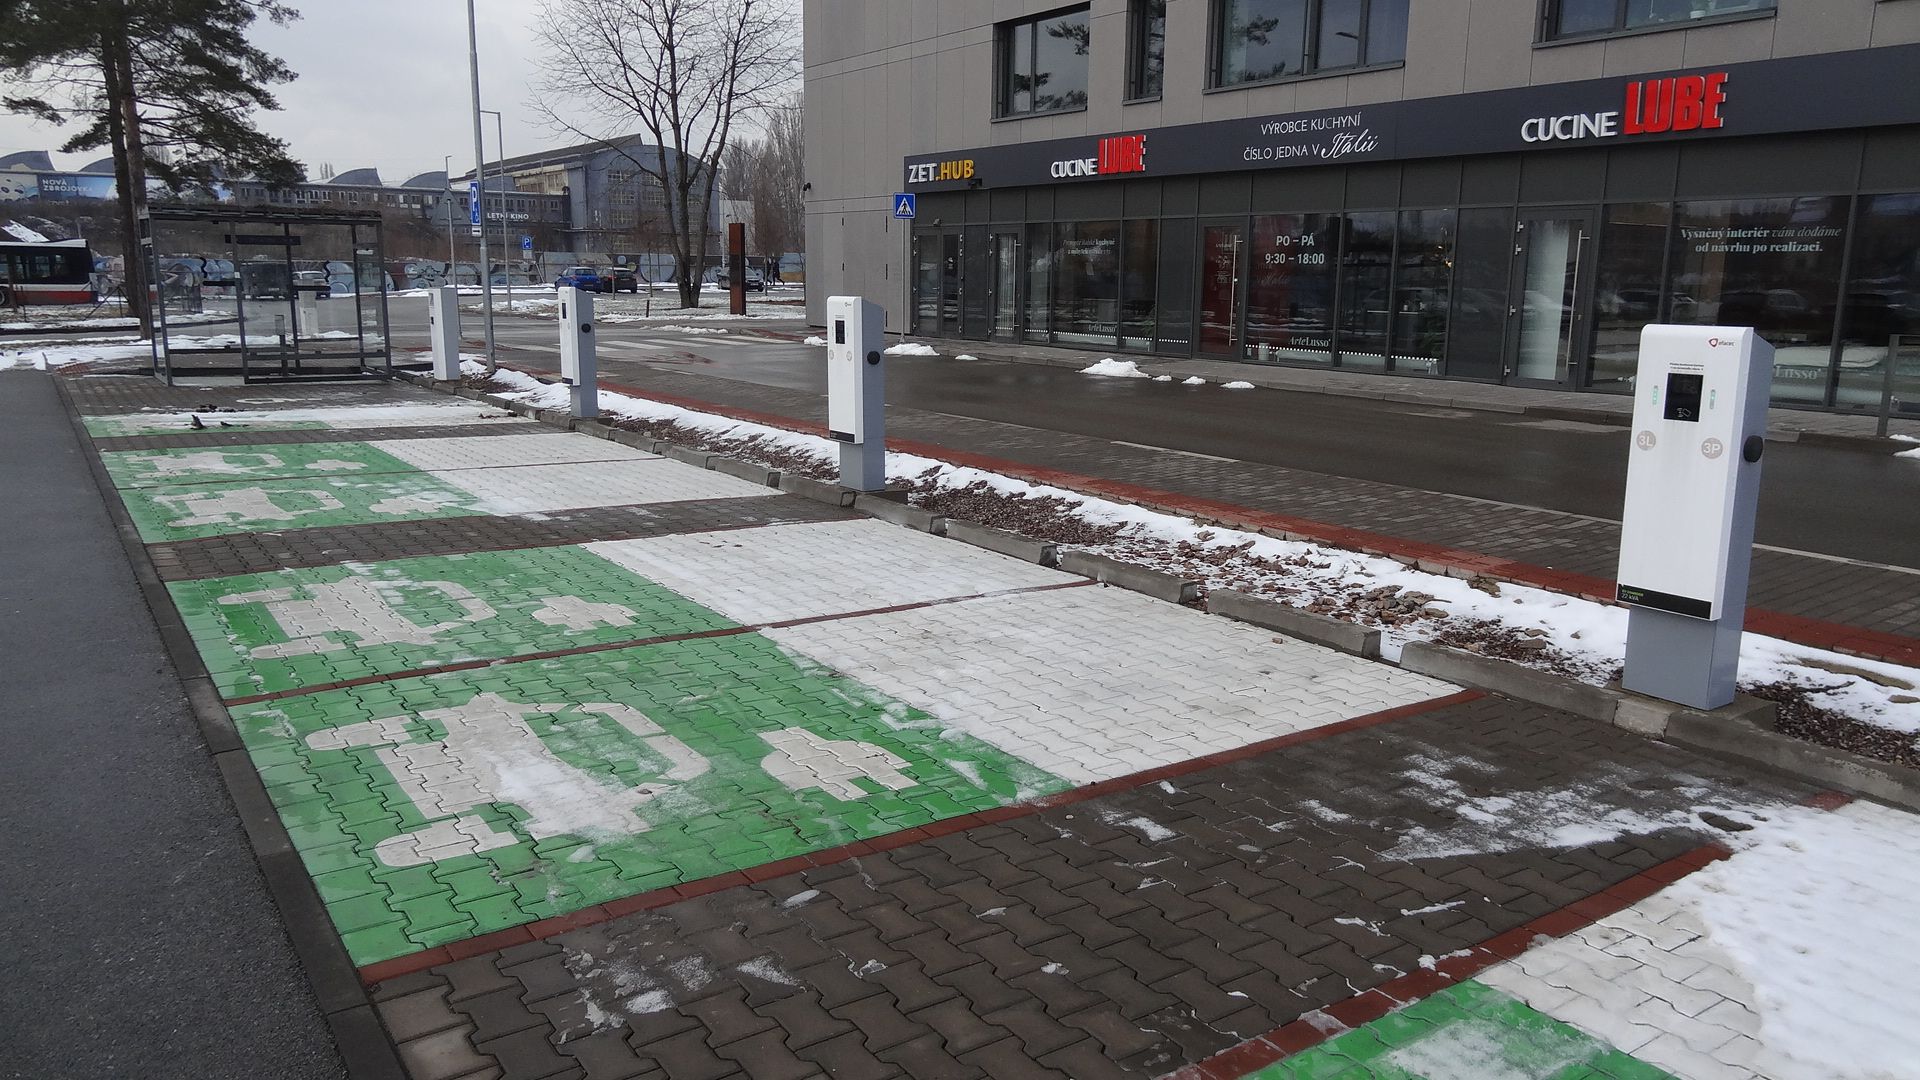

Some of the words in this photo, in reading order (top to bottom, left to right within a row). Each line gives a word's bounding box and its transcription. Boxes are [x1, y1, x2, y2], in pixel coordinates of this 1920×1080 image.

[1521, 111, 1619, 143] CUCINE
[1624, 72, 1729, 135] LUBE
[1261, 119, 1308, 135] VÝROBCE
[1311, 111, 1362, 131] KUCHYNÍ
[1243, 146, 1273, 161] ČÍSLO
[1274, 144, 1309, 161] JEDNA
[1312, 143, 1321, 156] V
[1320, 128, 1379, 159] Itálii
[1050, 158, 1098, 178] CUCINE
[1097, 134, 1147, 175] LUBE
[908, 159, 975, 183] ZET.HUB
[1275, 235, 1291, 247] PO
[1301, 232, 1315, 247] PÁ
[1680, 227, 1726, 241] Vysněný
[1727, 227, 1770, 239] interiér
[1771, 227, 1796, 238] vám
[1797, 225, 1842, 238] dodáme
[1695, 242, 1710, 253] od
[1711, 242, 1750, 253] návrhu
[1751, 244, 1768, 254] po
[1769, 241, 1824, 253] realizaci.
[1265, 253, 1286, 264] 9:30
[1297, 253, 1325, 265] 18:00
[1639, 435, 1654, 447] 3L
[1703, 442, 1721, 454] 3P
